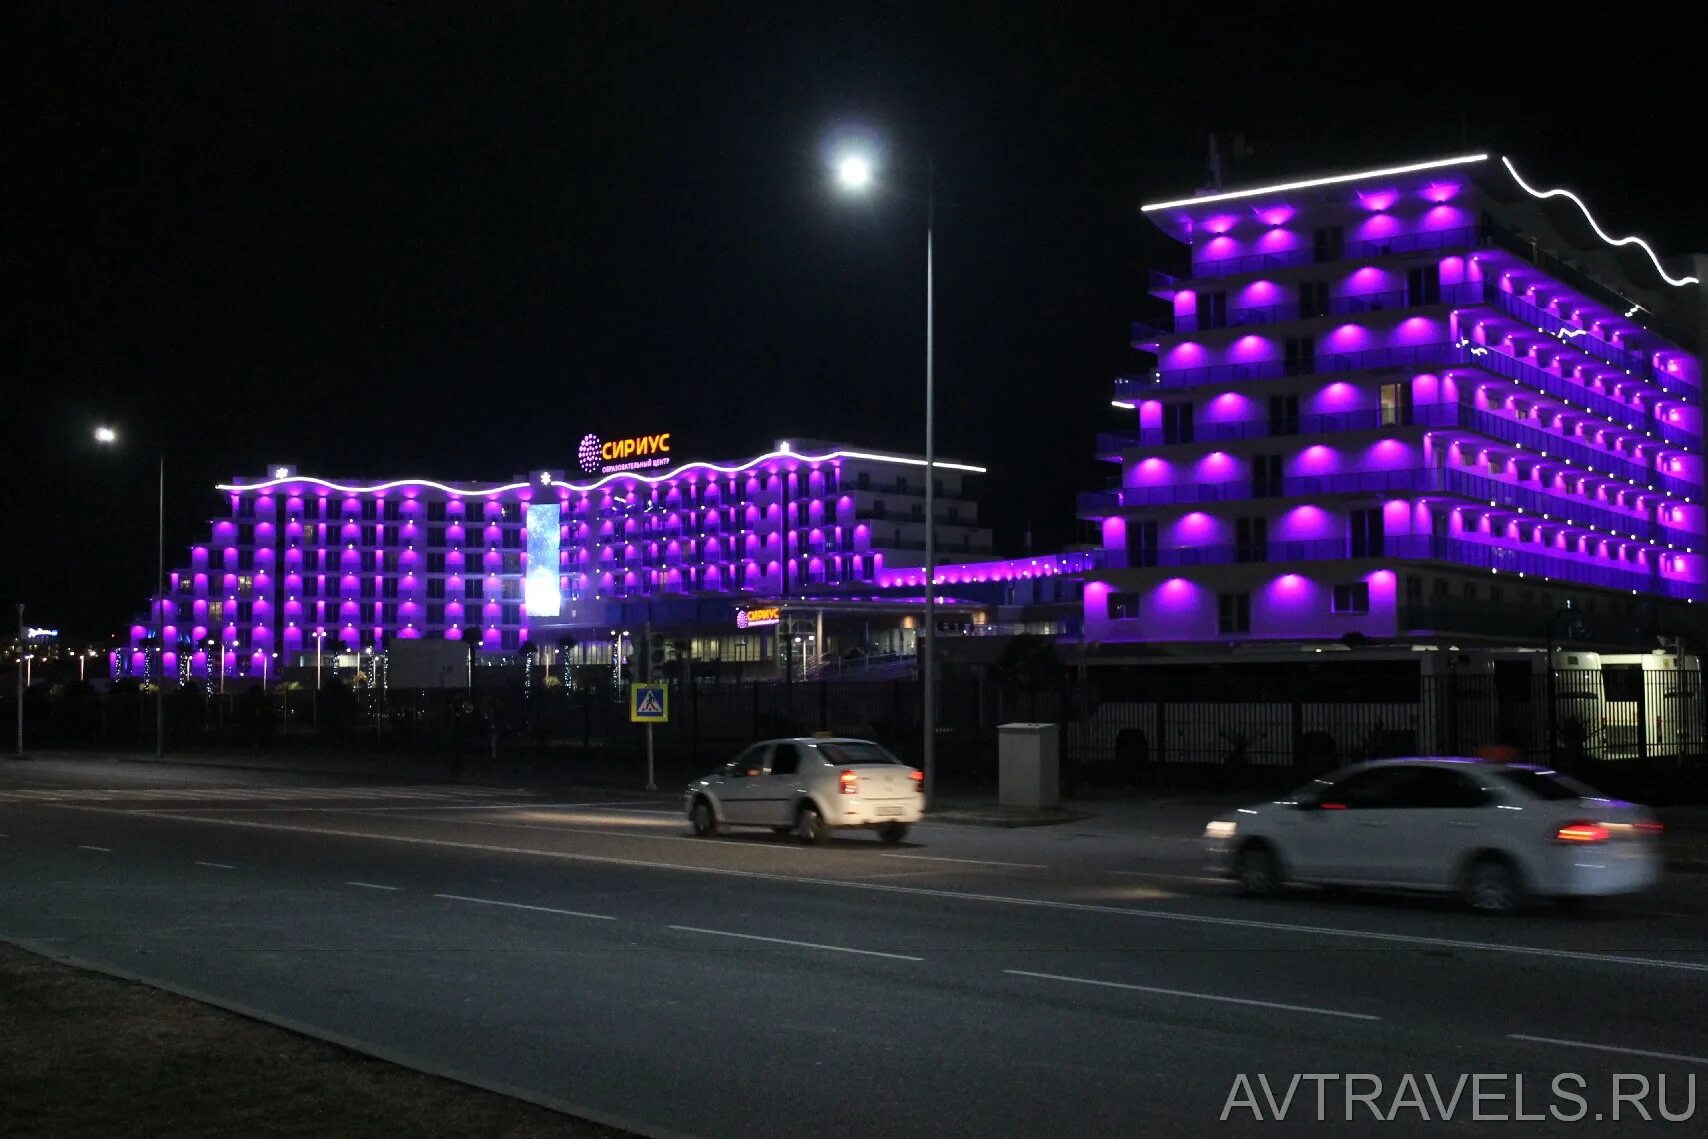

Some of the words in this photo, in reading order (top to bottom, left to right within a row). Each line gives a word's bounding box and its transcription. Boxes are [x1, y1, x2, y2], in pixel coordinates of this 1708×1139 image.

[602, 433, 670, 460] СИРИУС
[602, 458, 652, 473] ОБРАЗОВАТЕЛЬНЫЙ
[652, 457, 670, 467] ЦЕНТР
